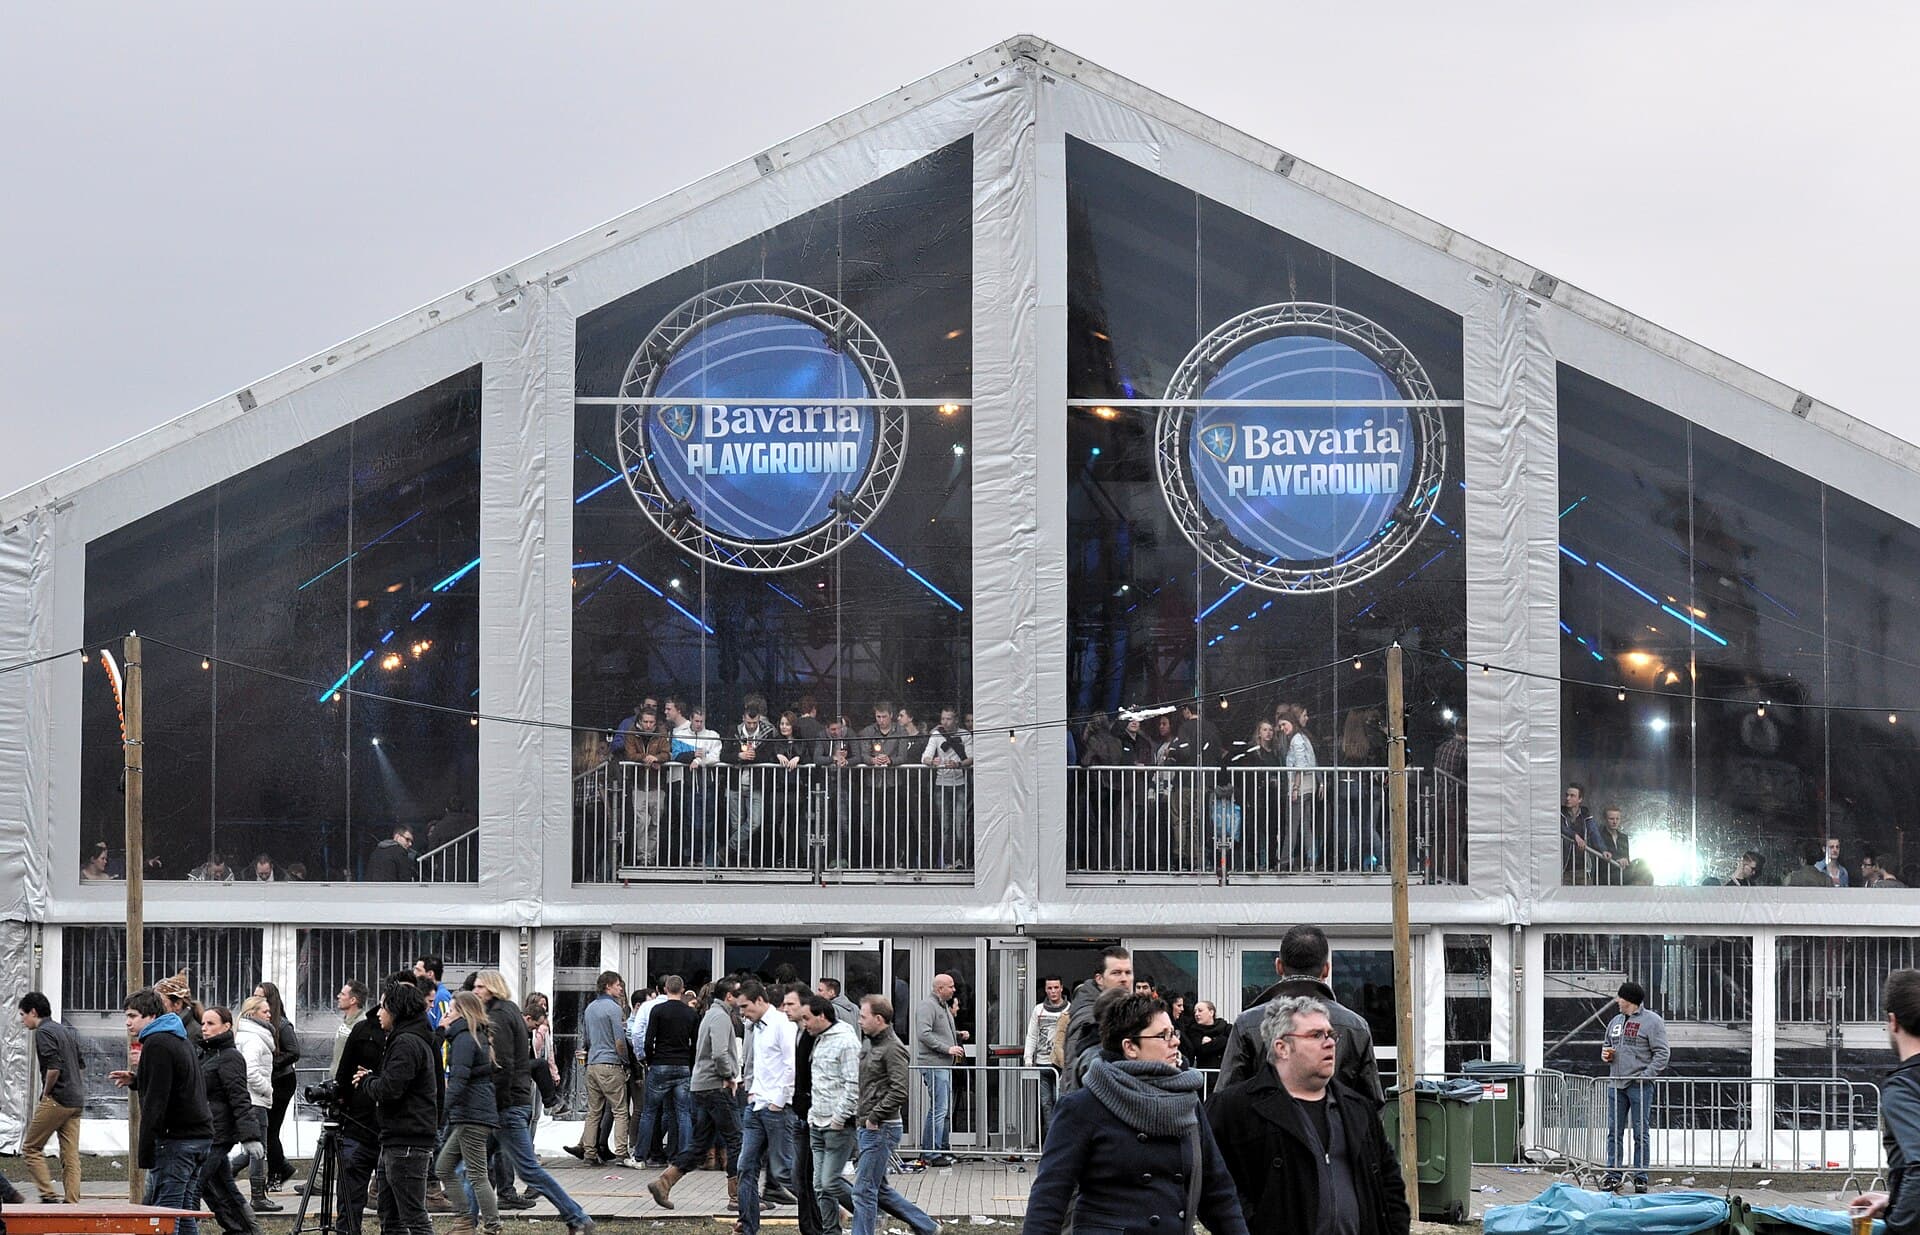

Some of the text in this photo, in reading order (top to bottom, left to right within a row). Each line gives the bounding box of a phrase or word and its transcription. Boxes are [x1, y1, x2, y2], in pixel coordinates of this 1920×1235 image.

[704, 404, 861, 438] Bavaria
[1242, 419, 1402, 460] Bavaria
[687, 441, 858, 475] PLAYGROUND
[1228, 462, 1399, 497] PLAYGROUND
